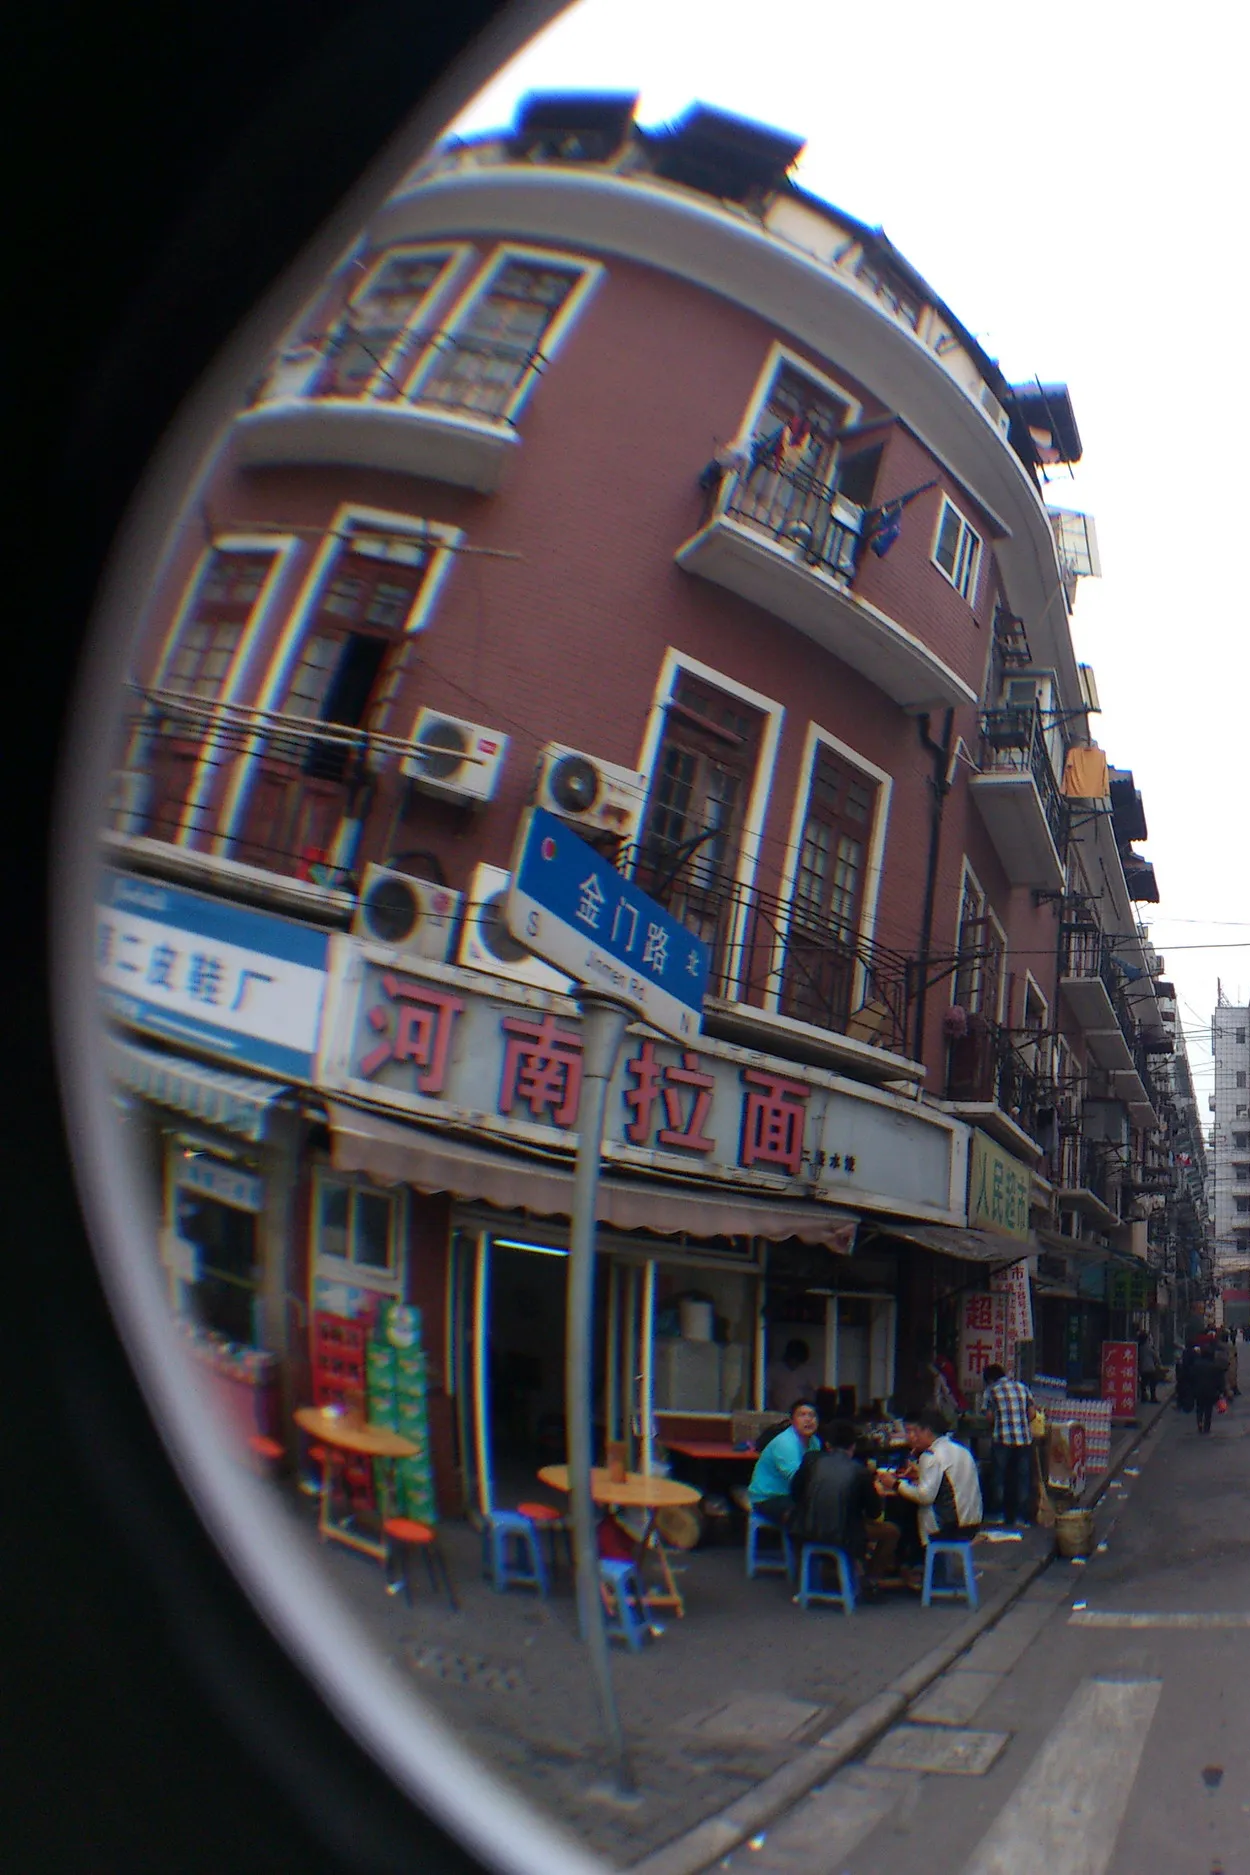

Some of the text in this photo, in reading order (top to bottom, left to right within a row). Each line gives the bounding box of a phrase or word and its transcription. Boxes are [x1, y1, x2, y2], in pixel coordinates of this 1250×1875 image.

[526, 911, 540, 938] S
[679, 1013, 690, 1035] N
[575, 872, 700, 977] 金门路 北
[361, 972, 812, 1176] 河南拉面
[976, 1152, 1029, 1232] 人民超市
[965, 1294, 993, 1375] 超市
